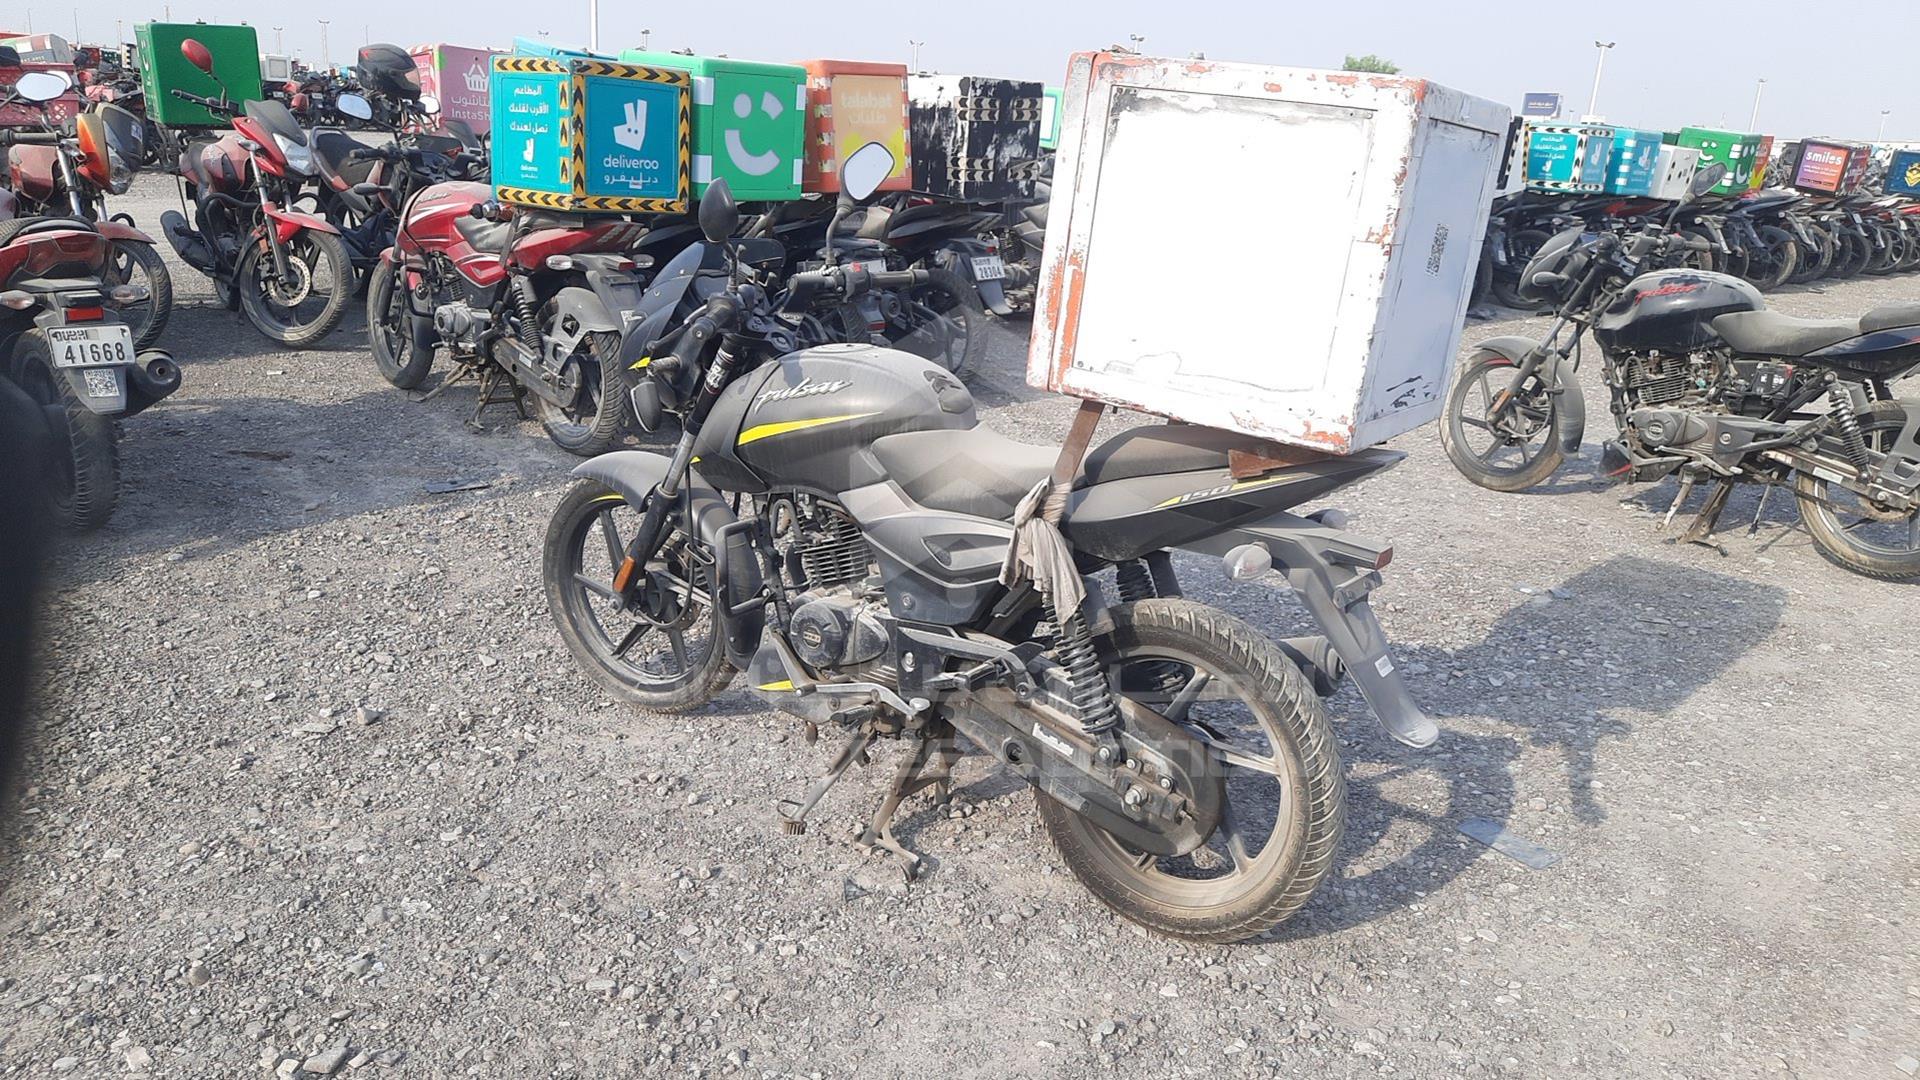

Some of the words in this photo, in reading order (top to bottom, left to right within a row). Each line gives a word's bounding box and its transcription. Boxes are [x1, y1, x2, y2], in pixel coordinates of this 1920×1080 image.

[841, 91, 893, 108] talabat
[602, 153, 660, 170] deliveroo
[1805, 150, 1843, 165] smiles
[978, 264, 1003, 279] 28304
[64, 341, 126, 365] 41668
[1180, 484, 1232, 503] 150
